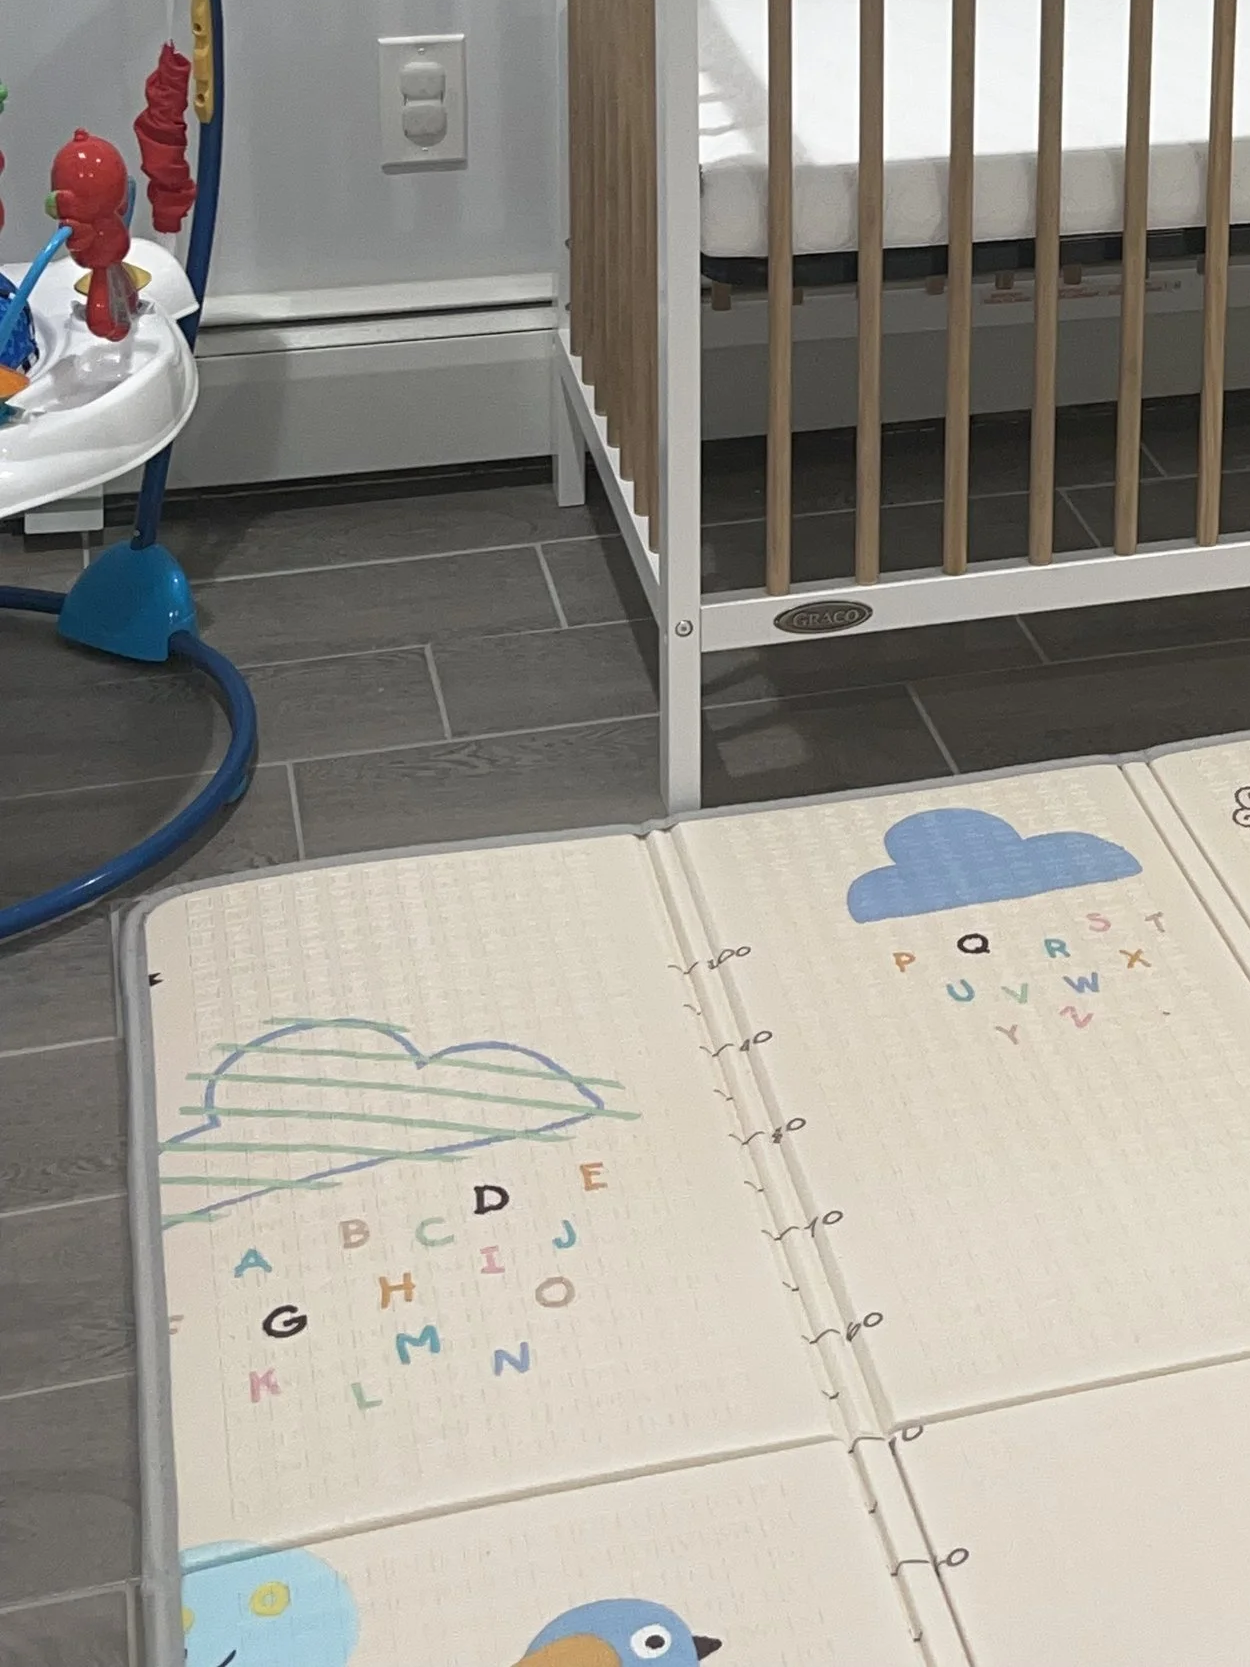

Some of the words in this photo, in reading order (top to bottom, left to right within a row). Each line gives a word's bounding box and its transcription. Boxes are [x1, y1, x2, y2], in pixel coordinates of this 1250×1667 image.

[793, 609, 859, 627] GRACO
[892, 952, 915, 972] P
[957, 934, 990, 954] Q
[1044, 939, 1071, 958] R
[1086, 914, 1111, 932] S
[1145, 912, 1165, 932] T
[946, 979, 975, 1002] U
[1063, 972, 1099, 993] W
[1119, 948, 1151, 968] X
[995, 1025, 1019, 1044] Y
[234, 1249, 272, 1277] A
[338, 1219, 369, 1249] B
[415, 1218, 453, 1247] C
[473, 1185, 509, 1215] D
[580, 1162, 608, 1191] E
[262, 1305, 307, 1337] G
[379, 1272, 415, 1309] H
[480, 1246, 504, 1274] I
[552, 1220, 577, 1250] J
[351, 1382, 382, 1410] L
[396, 1326, 440, 1364] M
[493, 1342, 530, 1376] N
[535, 1276, 575, 1308] O
